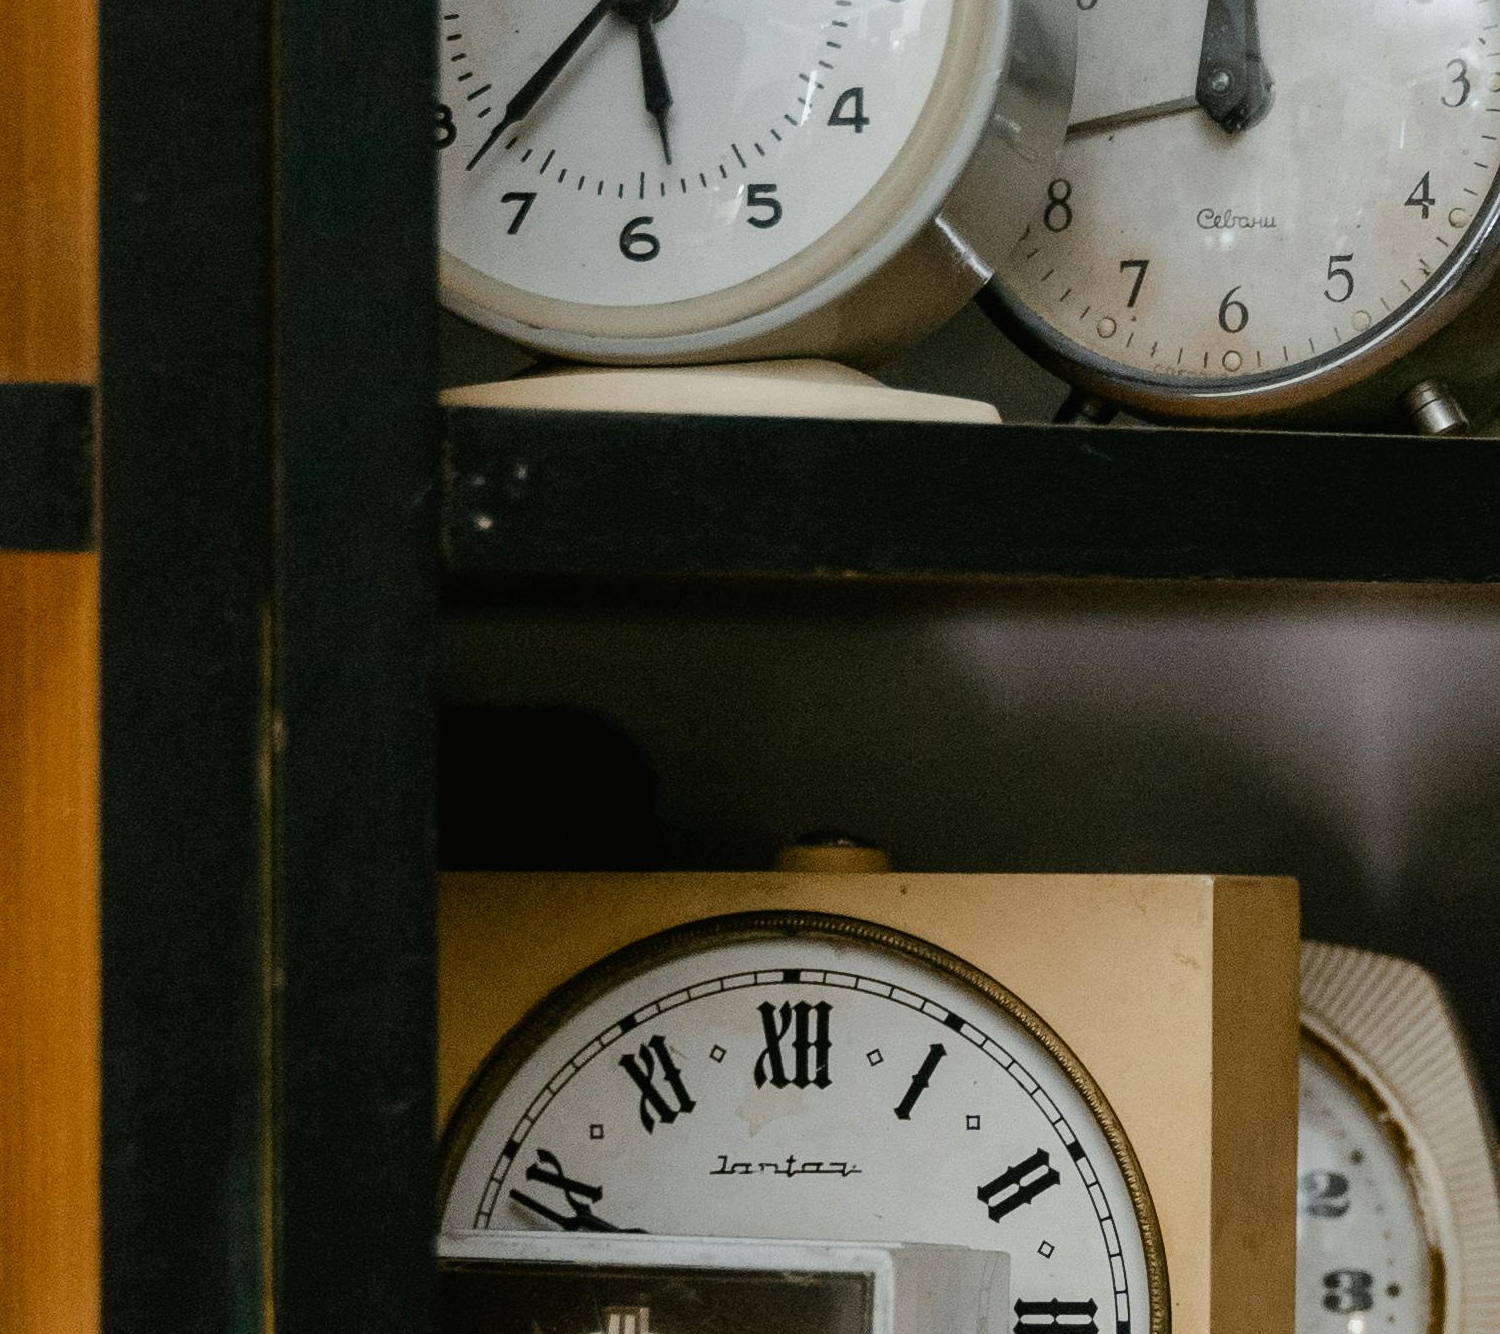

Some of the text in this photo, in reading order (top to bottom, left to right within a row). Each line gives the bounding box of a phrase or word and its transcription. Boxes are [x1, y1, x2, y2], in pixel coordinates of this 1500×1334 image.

[1440, 57, 1471, 109] 3
[827, 87, 870, 134] 4
[500, 191, 536, 235] 7
[745, 183, 783, 229] 5
[1043, 178, 1073, 232] 8
[1404, 170, 1436, 220] 4
[618, 216, 661, 262] 6
[1119, 258, 1150, 309] 7
[1323, 254, 1355, 303] 5
[1218, 285, 1250, 333] 6
[753, 999, 834, 1091] XII
[619, 1033, 698, 1136] XI
[893, 1041, 948, 1121] I
[975, 1147, 1062, 1224] II
[1298, 1171, 1351, 1219] 2
[1322, 1269, 1373, 1316] 3
